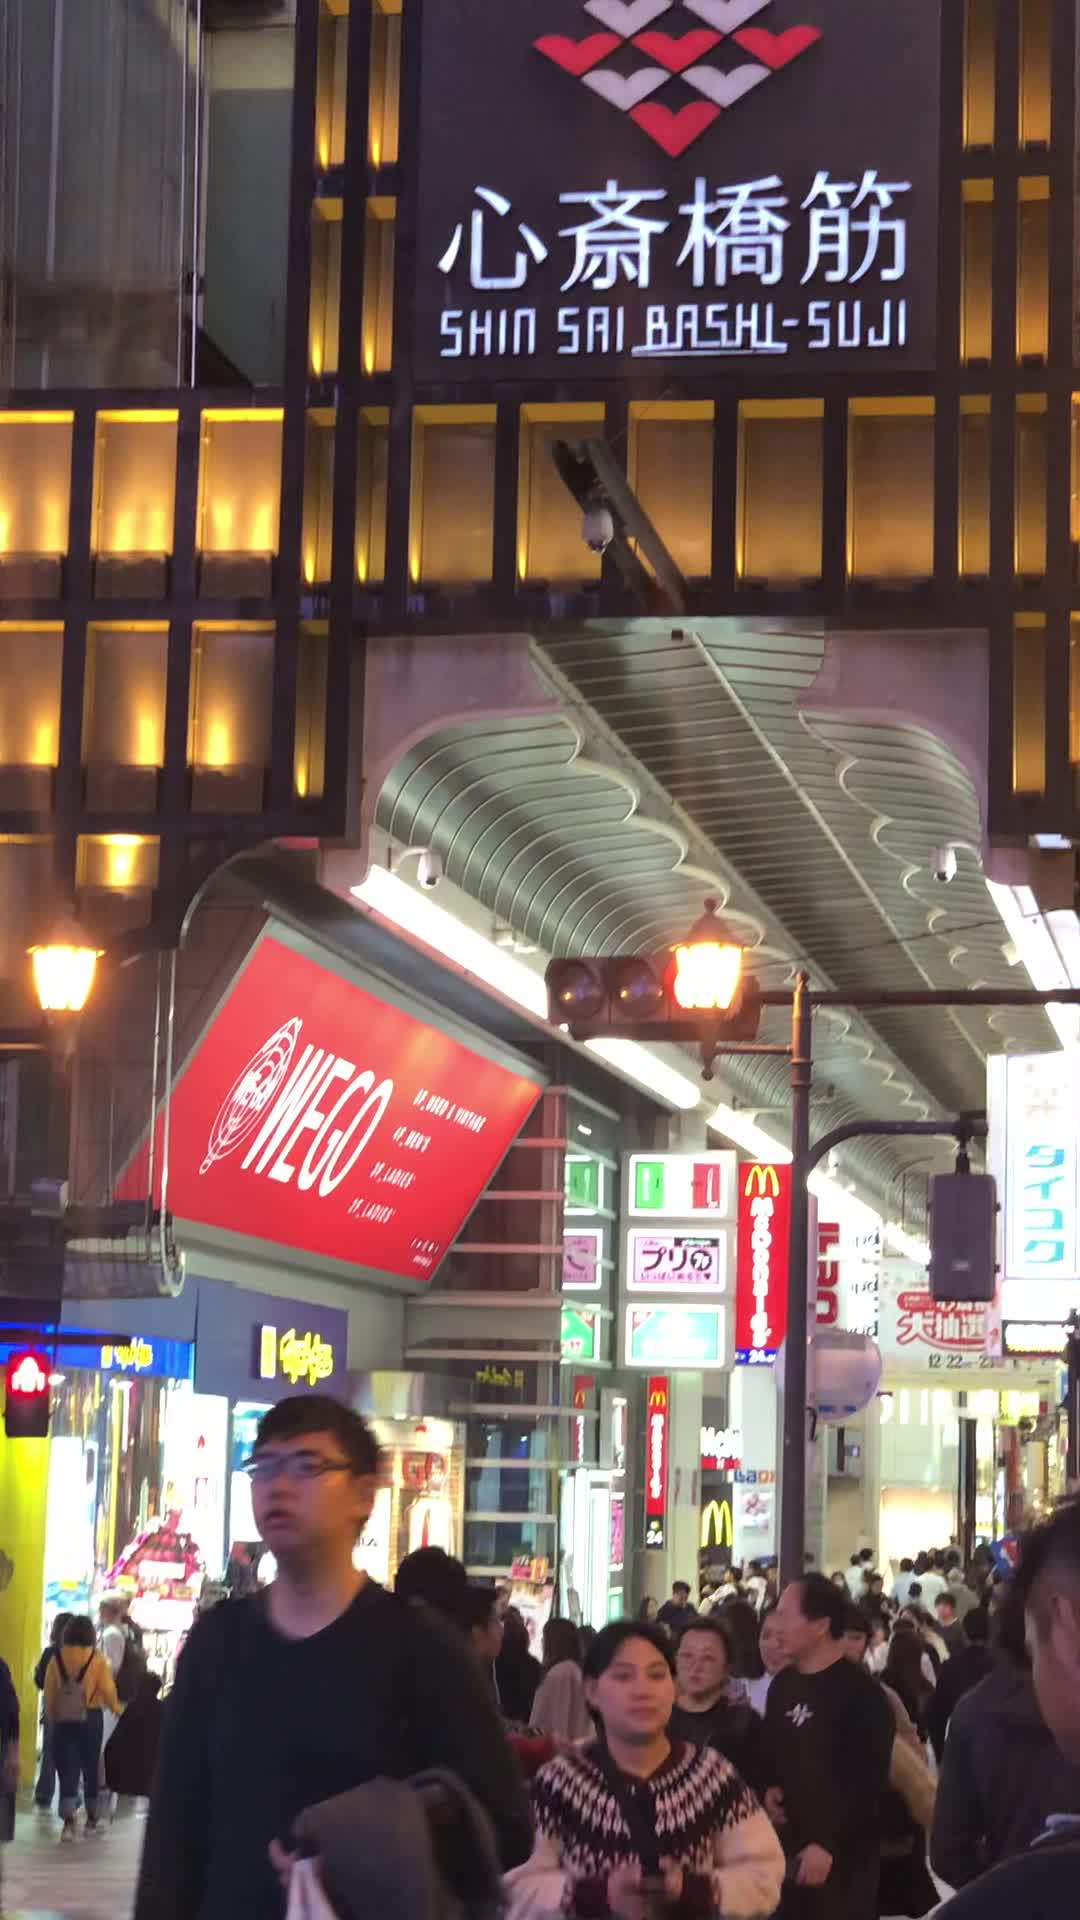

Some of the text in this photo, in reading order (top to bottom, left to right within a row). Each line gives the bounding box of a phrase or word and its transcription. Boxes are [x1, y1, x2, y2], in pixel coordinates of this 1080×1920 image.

[438, 170, 912, 292] 心斎橋筋
[440, 308, 536, 357] SHIN
[557, 306, 625, 355] SAI
[240, 1043, 394, 1197] WEGO
